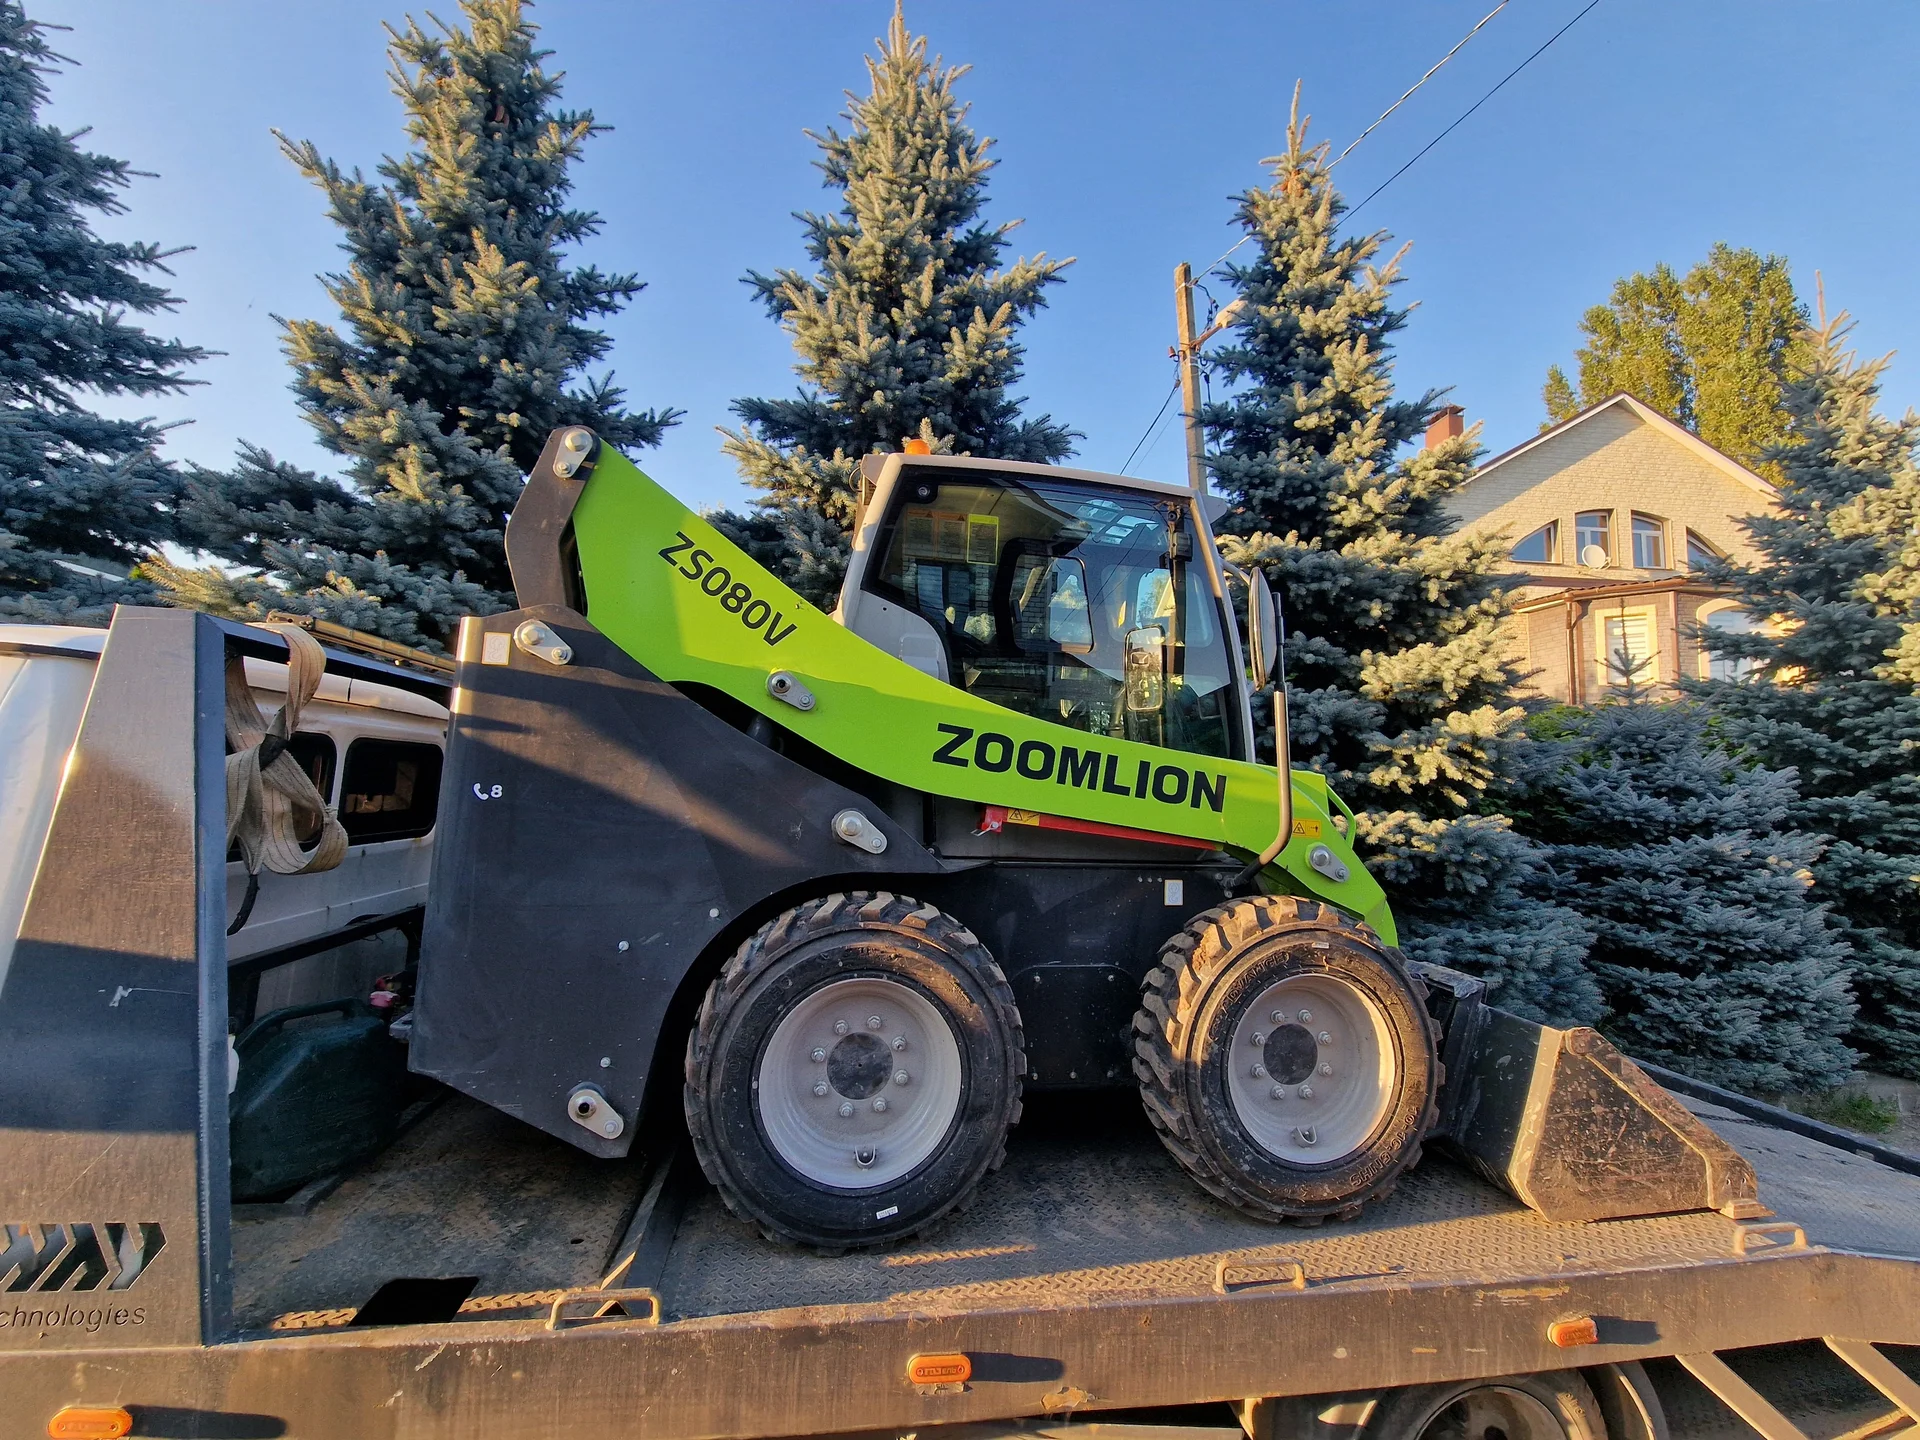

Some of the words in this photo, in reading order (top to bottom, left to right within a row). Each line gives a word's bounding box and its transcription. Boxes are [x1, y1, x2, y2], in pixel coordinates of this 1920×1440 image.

[658, 531, 798, 647] ZS080V
[490, 784, 503, 798] 8
[932, 722, 1228, 813] ZOOMLION
